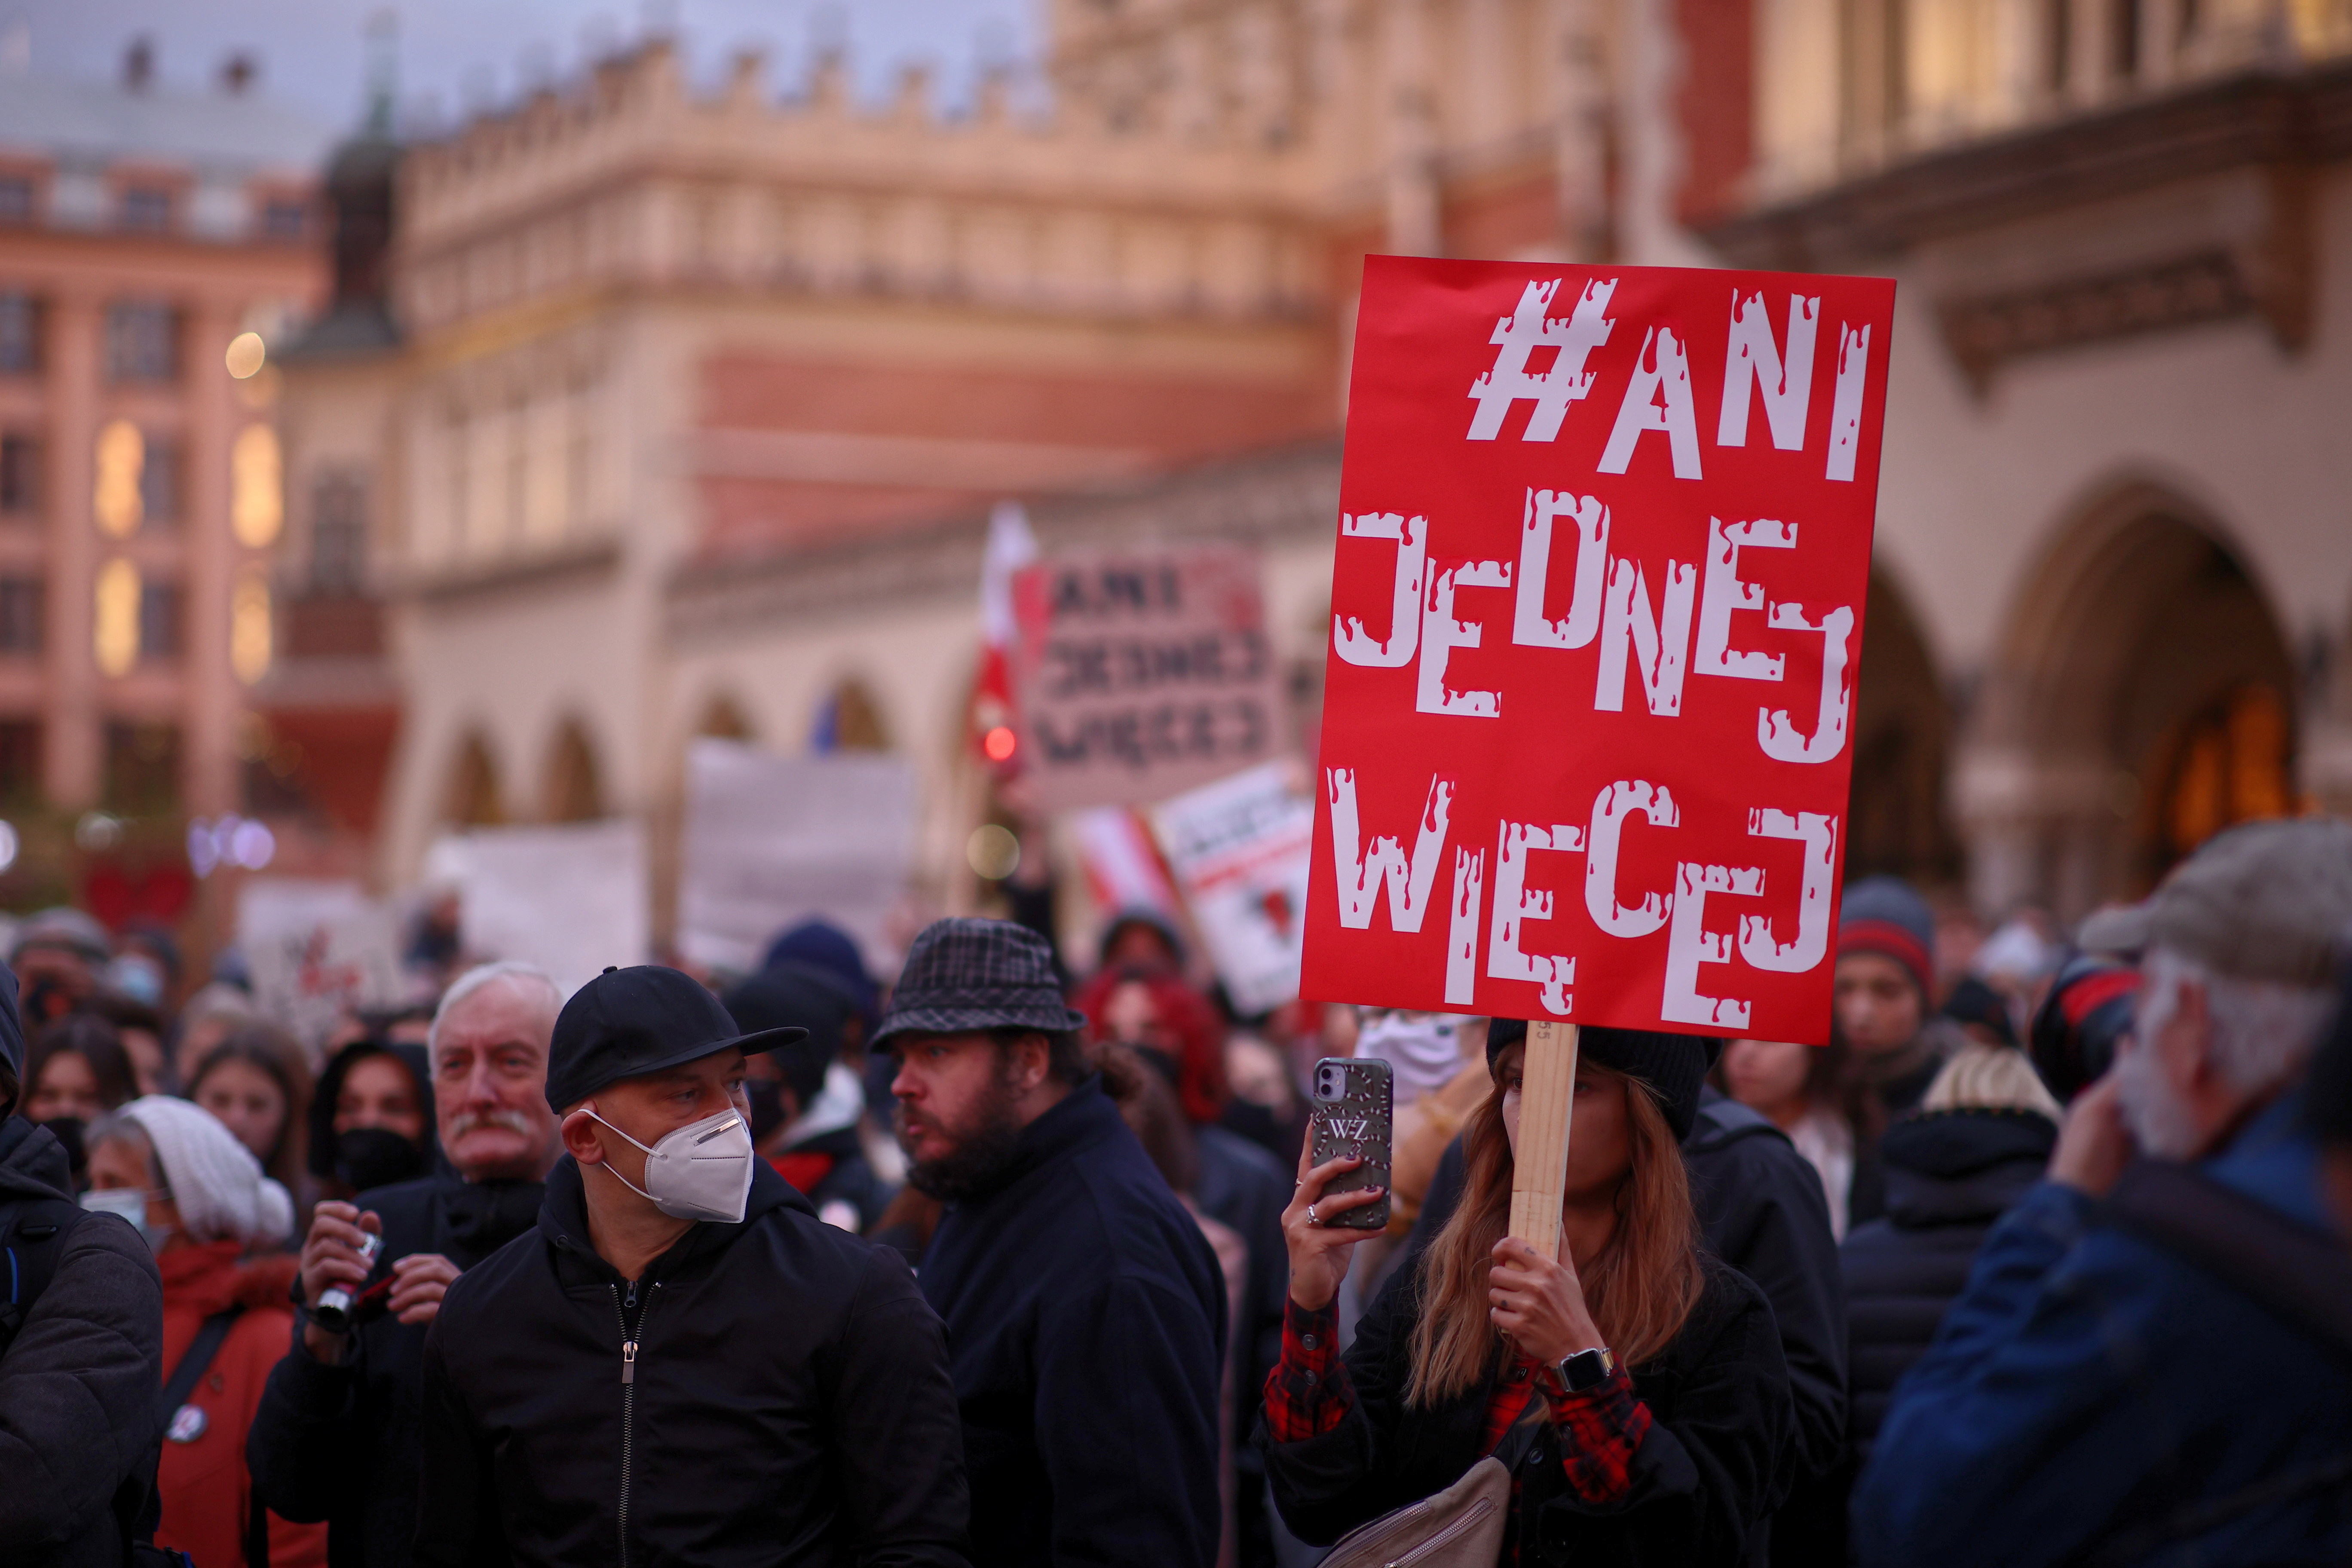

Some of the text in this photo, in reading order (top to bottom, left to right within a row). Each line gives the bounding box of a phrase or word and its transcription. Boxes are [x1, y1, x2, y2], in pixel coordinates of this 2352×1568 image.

[1466, 277, 1871, 482] #ANI
[1334, 486, 1854, 764] JEDNEJ
[1326, 766, 1838, 1030] WIĘCEJ
[1329, 1119, 1368, 1140] WZ
